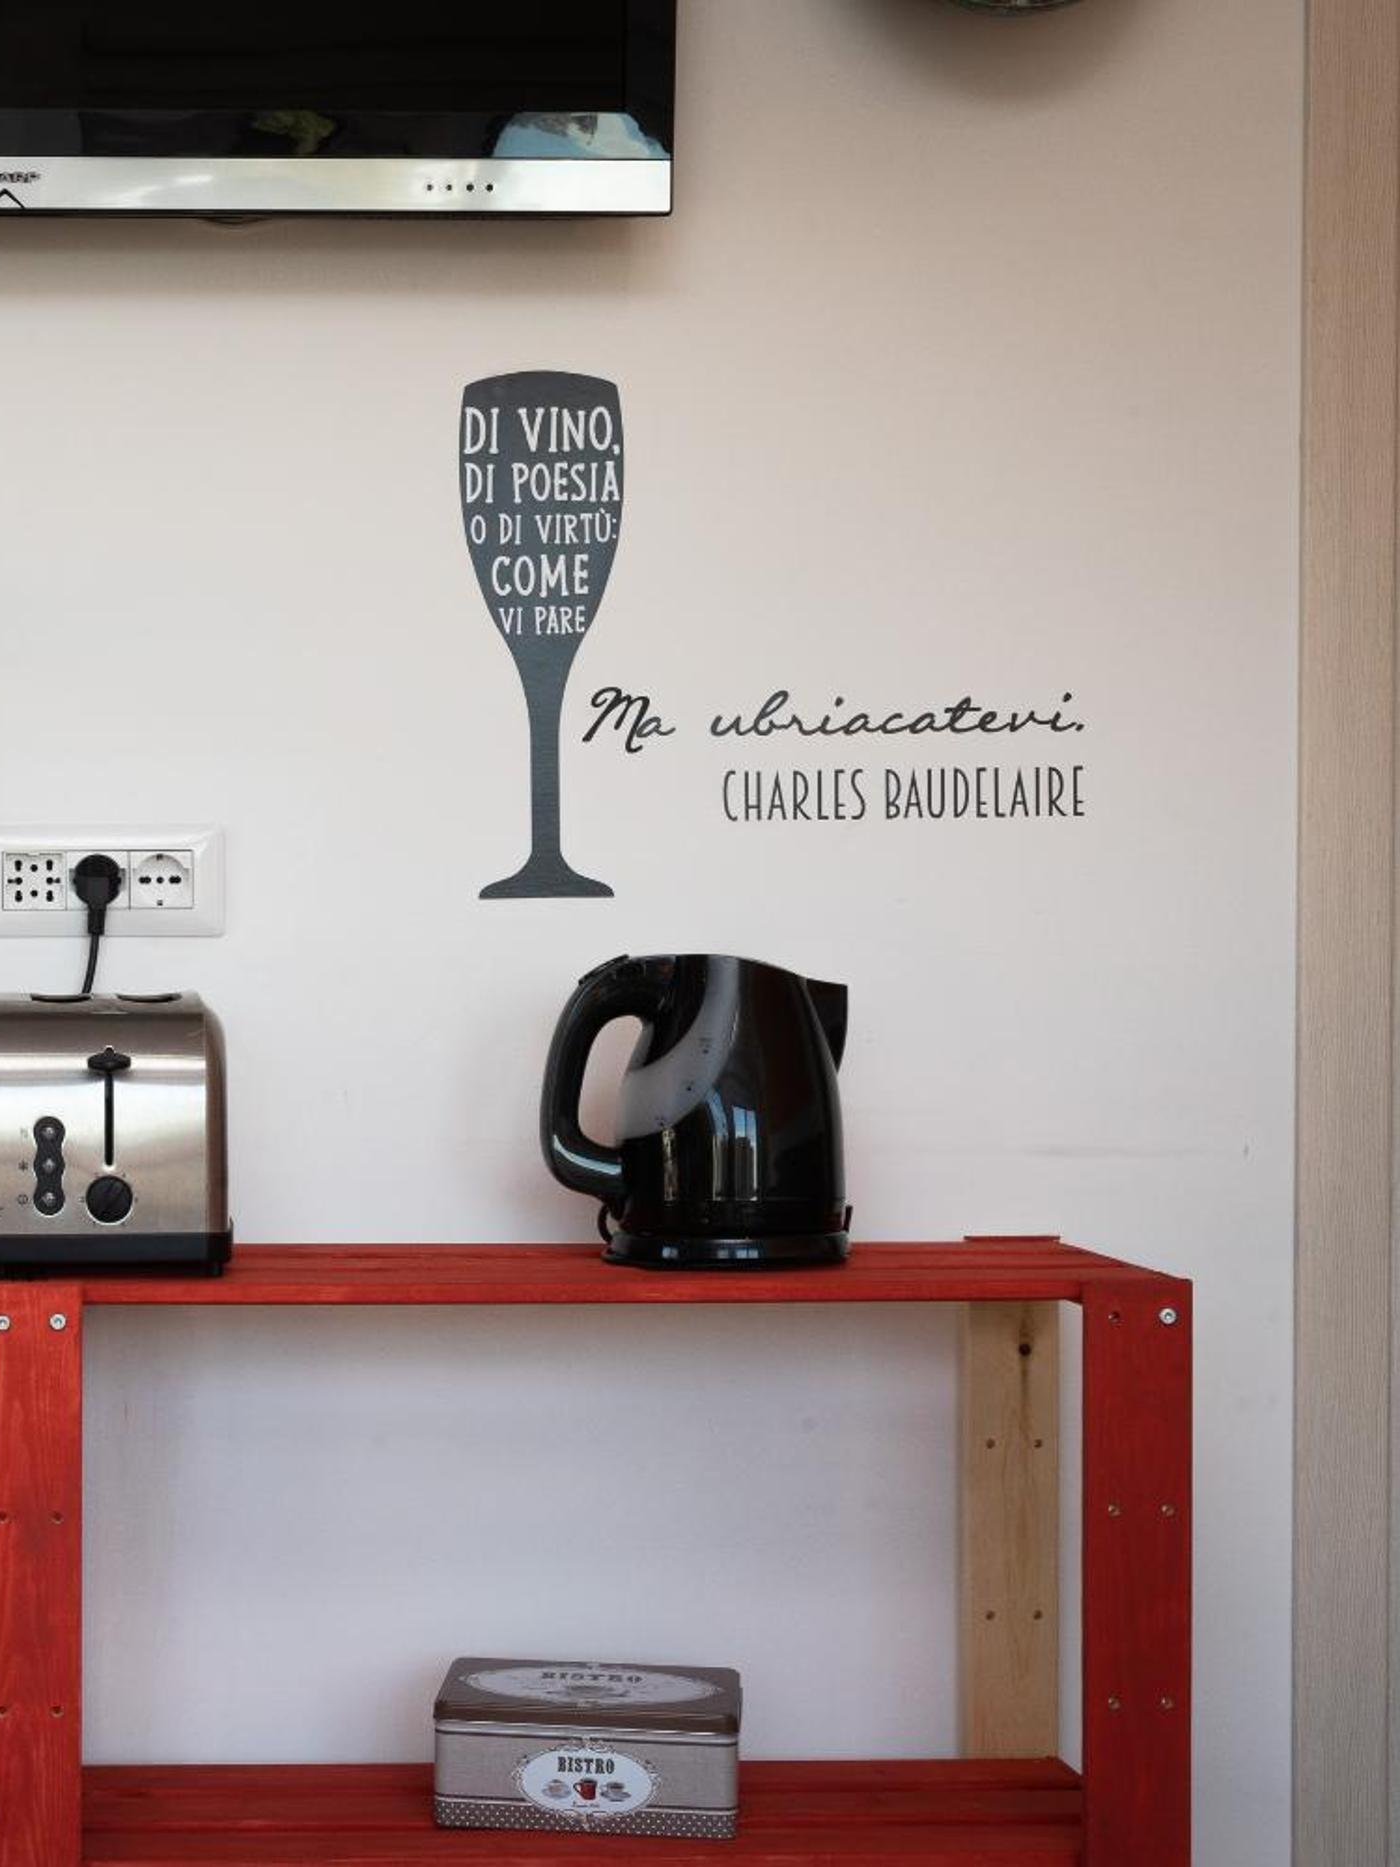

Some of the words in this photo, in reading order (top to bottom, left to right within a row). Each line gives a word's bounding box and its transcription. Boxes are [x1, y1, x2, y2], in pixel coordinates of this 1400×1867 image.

[463, 406, 500, 454] DI
[517, 406, 621, 455] VINO,
[464, 462, 496, 503] DI
[511, 461, 620, 504] POESIA
[470, 514, 486, 545] O
[498, 513, 522, 545] DI
[534, 508, 617, 545] VIRTÙ:
[491, 554, 589, 598] COME
[498, 607, 523, 635] VI
[534, 605, 586, 635] PARE
[582, 686, 676, 754] Ma
[710, 689, 1085, 736] ubriacatevi.
[723, 769, 866, 822] CHARLES
[885, 765, 1085, 819] BAUDELAIRE
[541, 1671, 643, 1684] BISTRO
[557, 1756, 615, 1775] BISTRO
